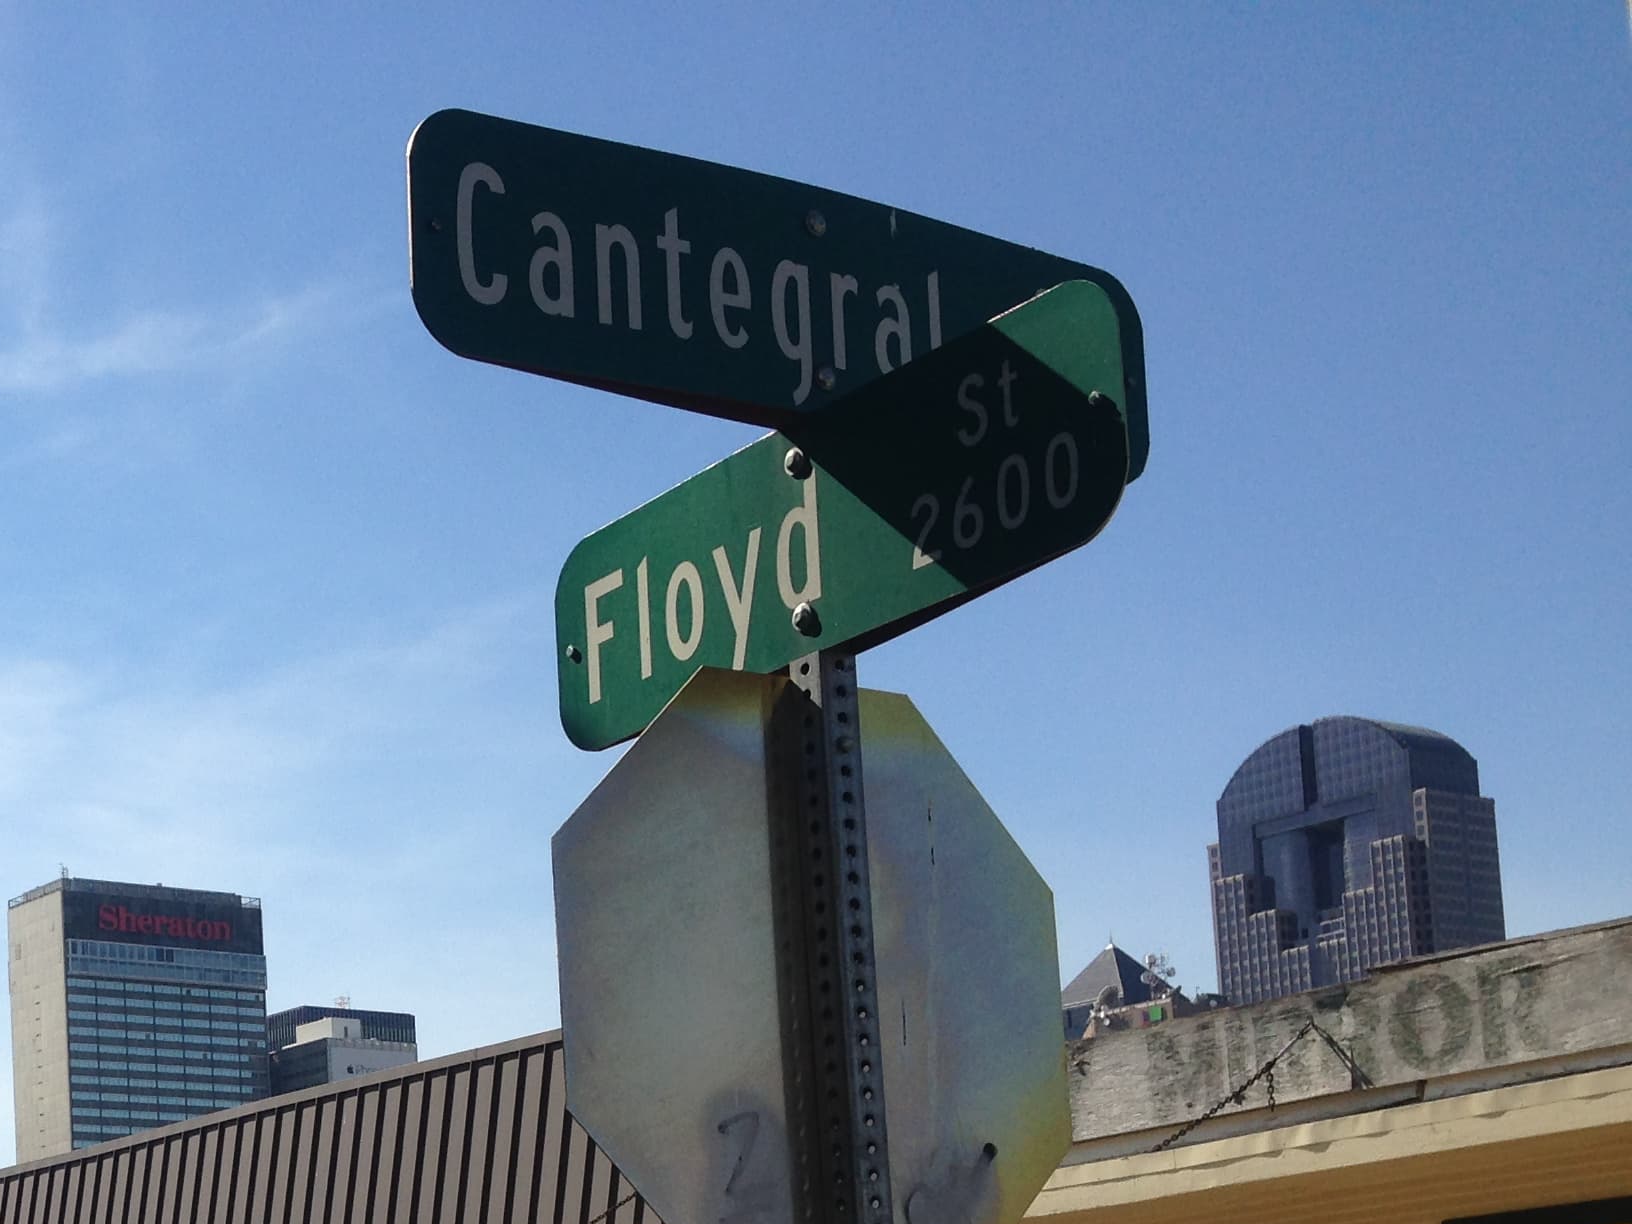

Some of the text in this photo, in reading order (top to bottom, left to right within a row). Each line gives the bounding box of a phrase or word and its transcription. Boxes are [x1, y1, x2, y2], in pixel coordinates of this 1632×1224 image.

[456, 162, 944, 403] Cantegral
[584, 359, 1019, 704] Floyd St
[911, 431, 1079, 569] 2600
[100, 904, 232, 941] Sheraton
